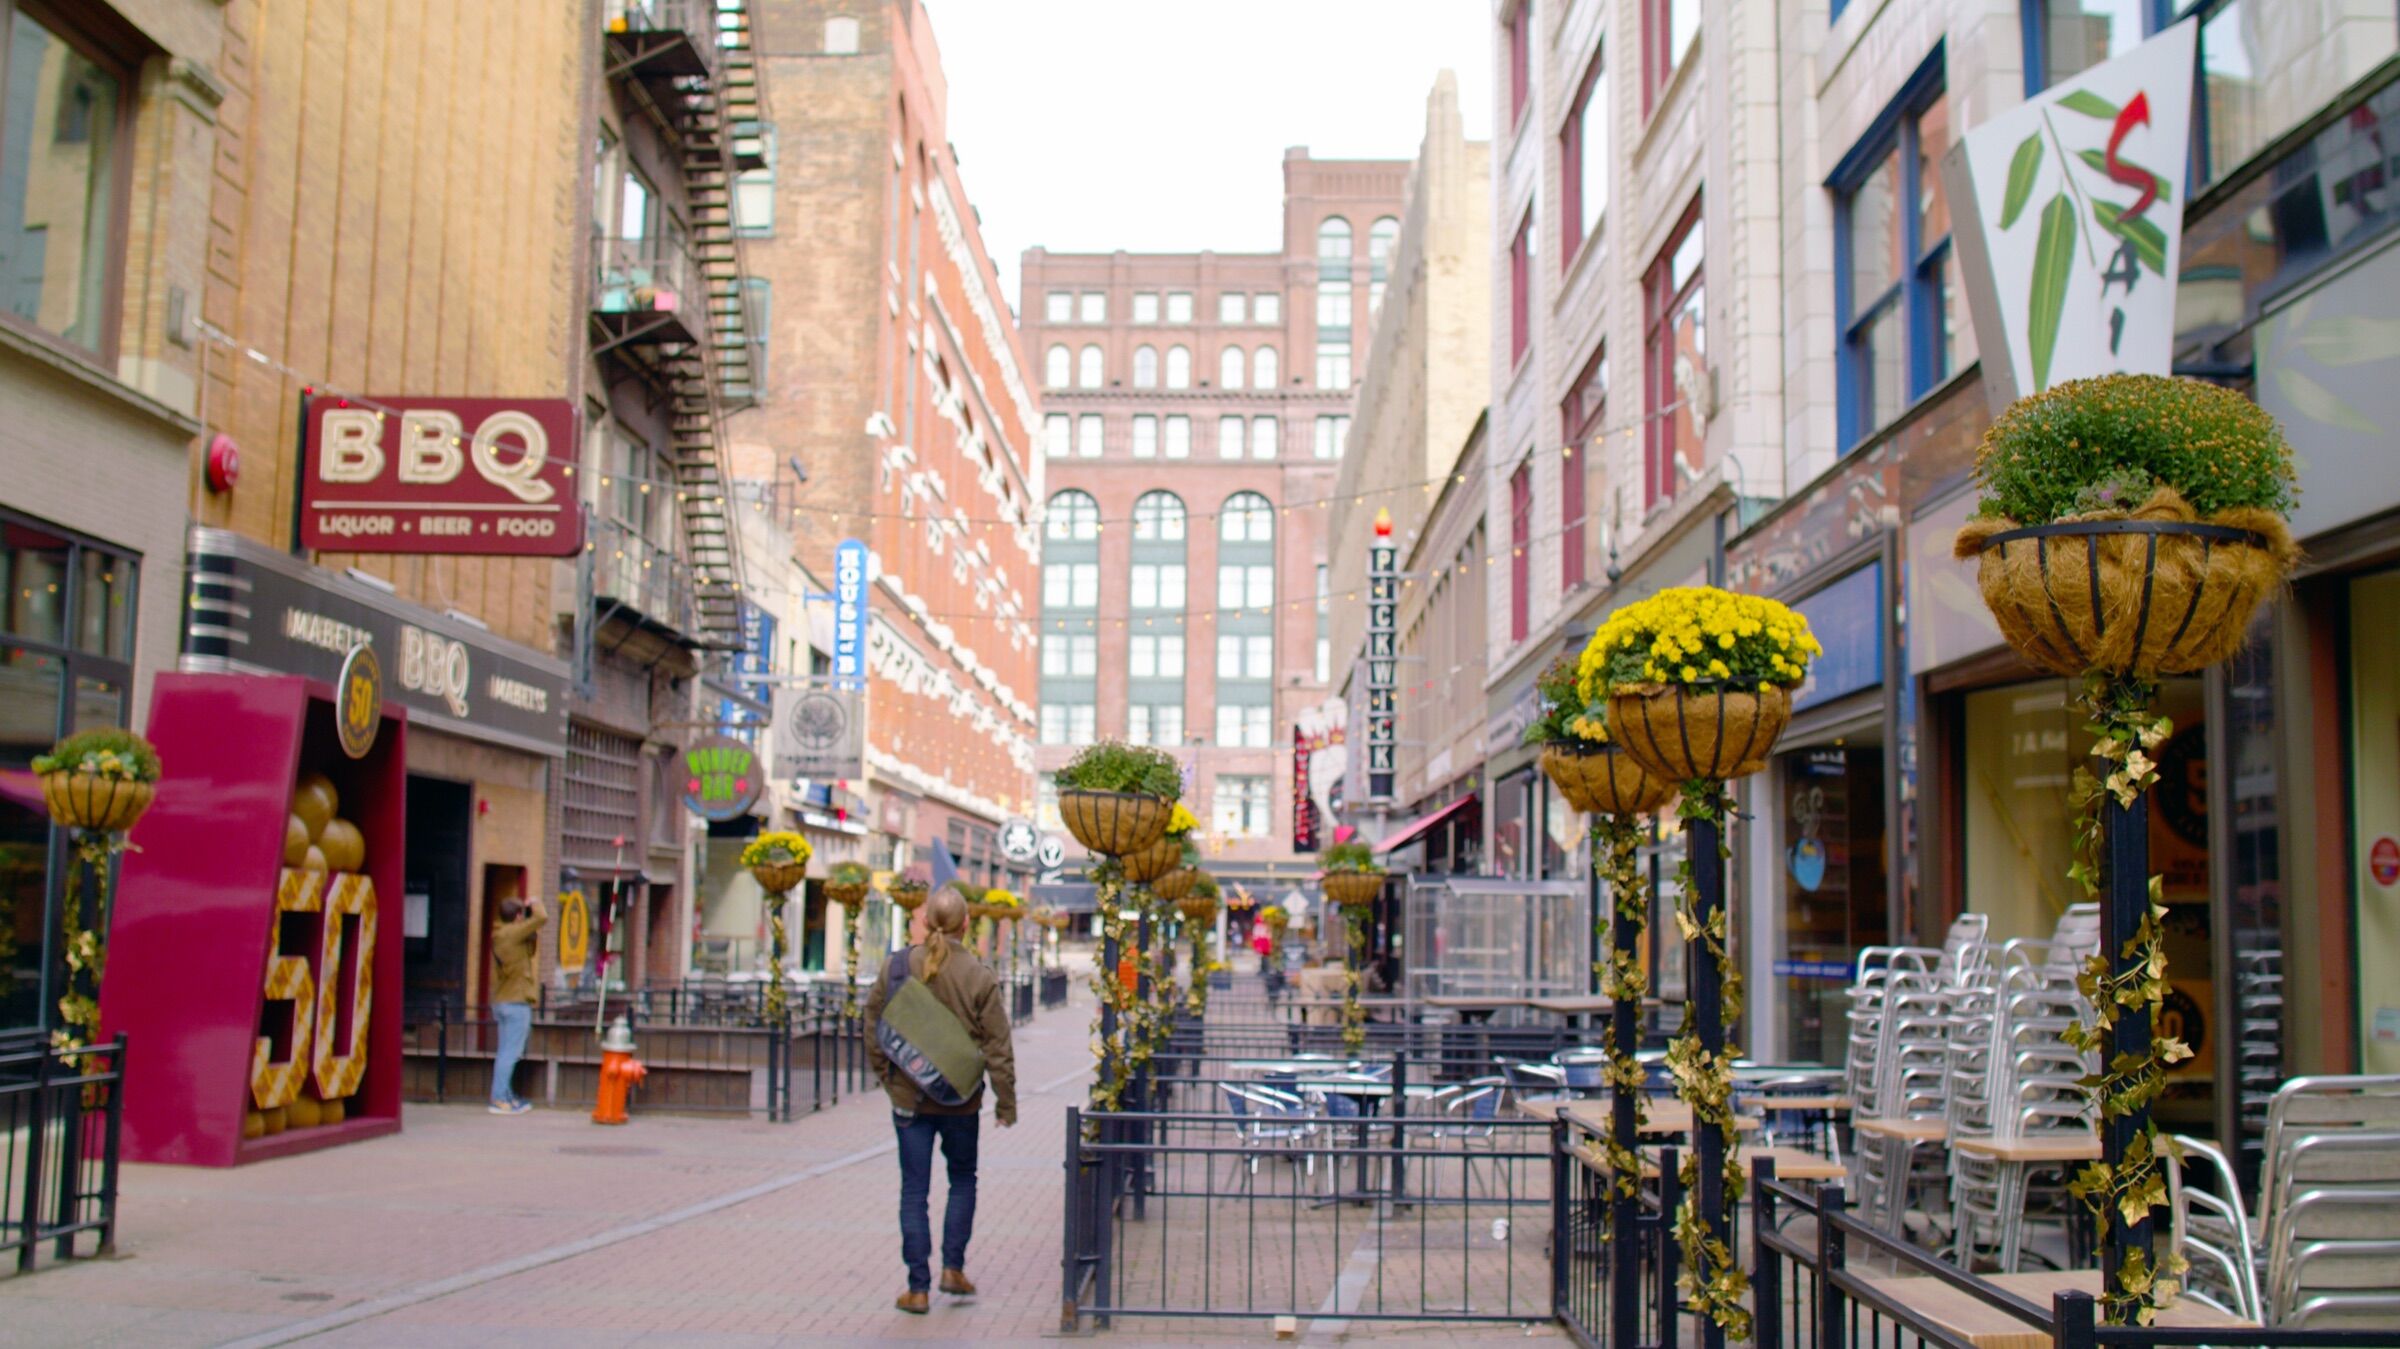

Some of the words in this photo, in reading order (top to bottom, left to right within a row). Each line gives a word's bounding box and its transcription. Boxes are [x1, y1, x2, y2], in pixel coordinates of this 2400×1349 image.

[2102, 90, 2157, 380] SAI
[320, 409, 554, 503] BBQ
[319, 515, 394, 537] LIQUOR
[419, 517, 472, 534] BEER
[497, 518, 555, 535] FOOD
[348, 674, 374, 730] 50
[399, 624, 470, 717] BBQ
[1374, 551, 1392, 768] PICKWICK
[703, 774, 733, 801] BAR
[252, 867, 379, 1109] 50
